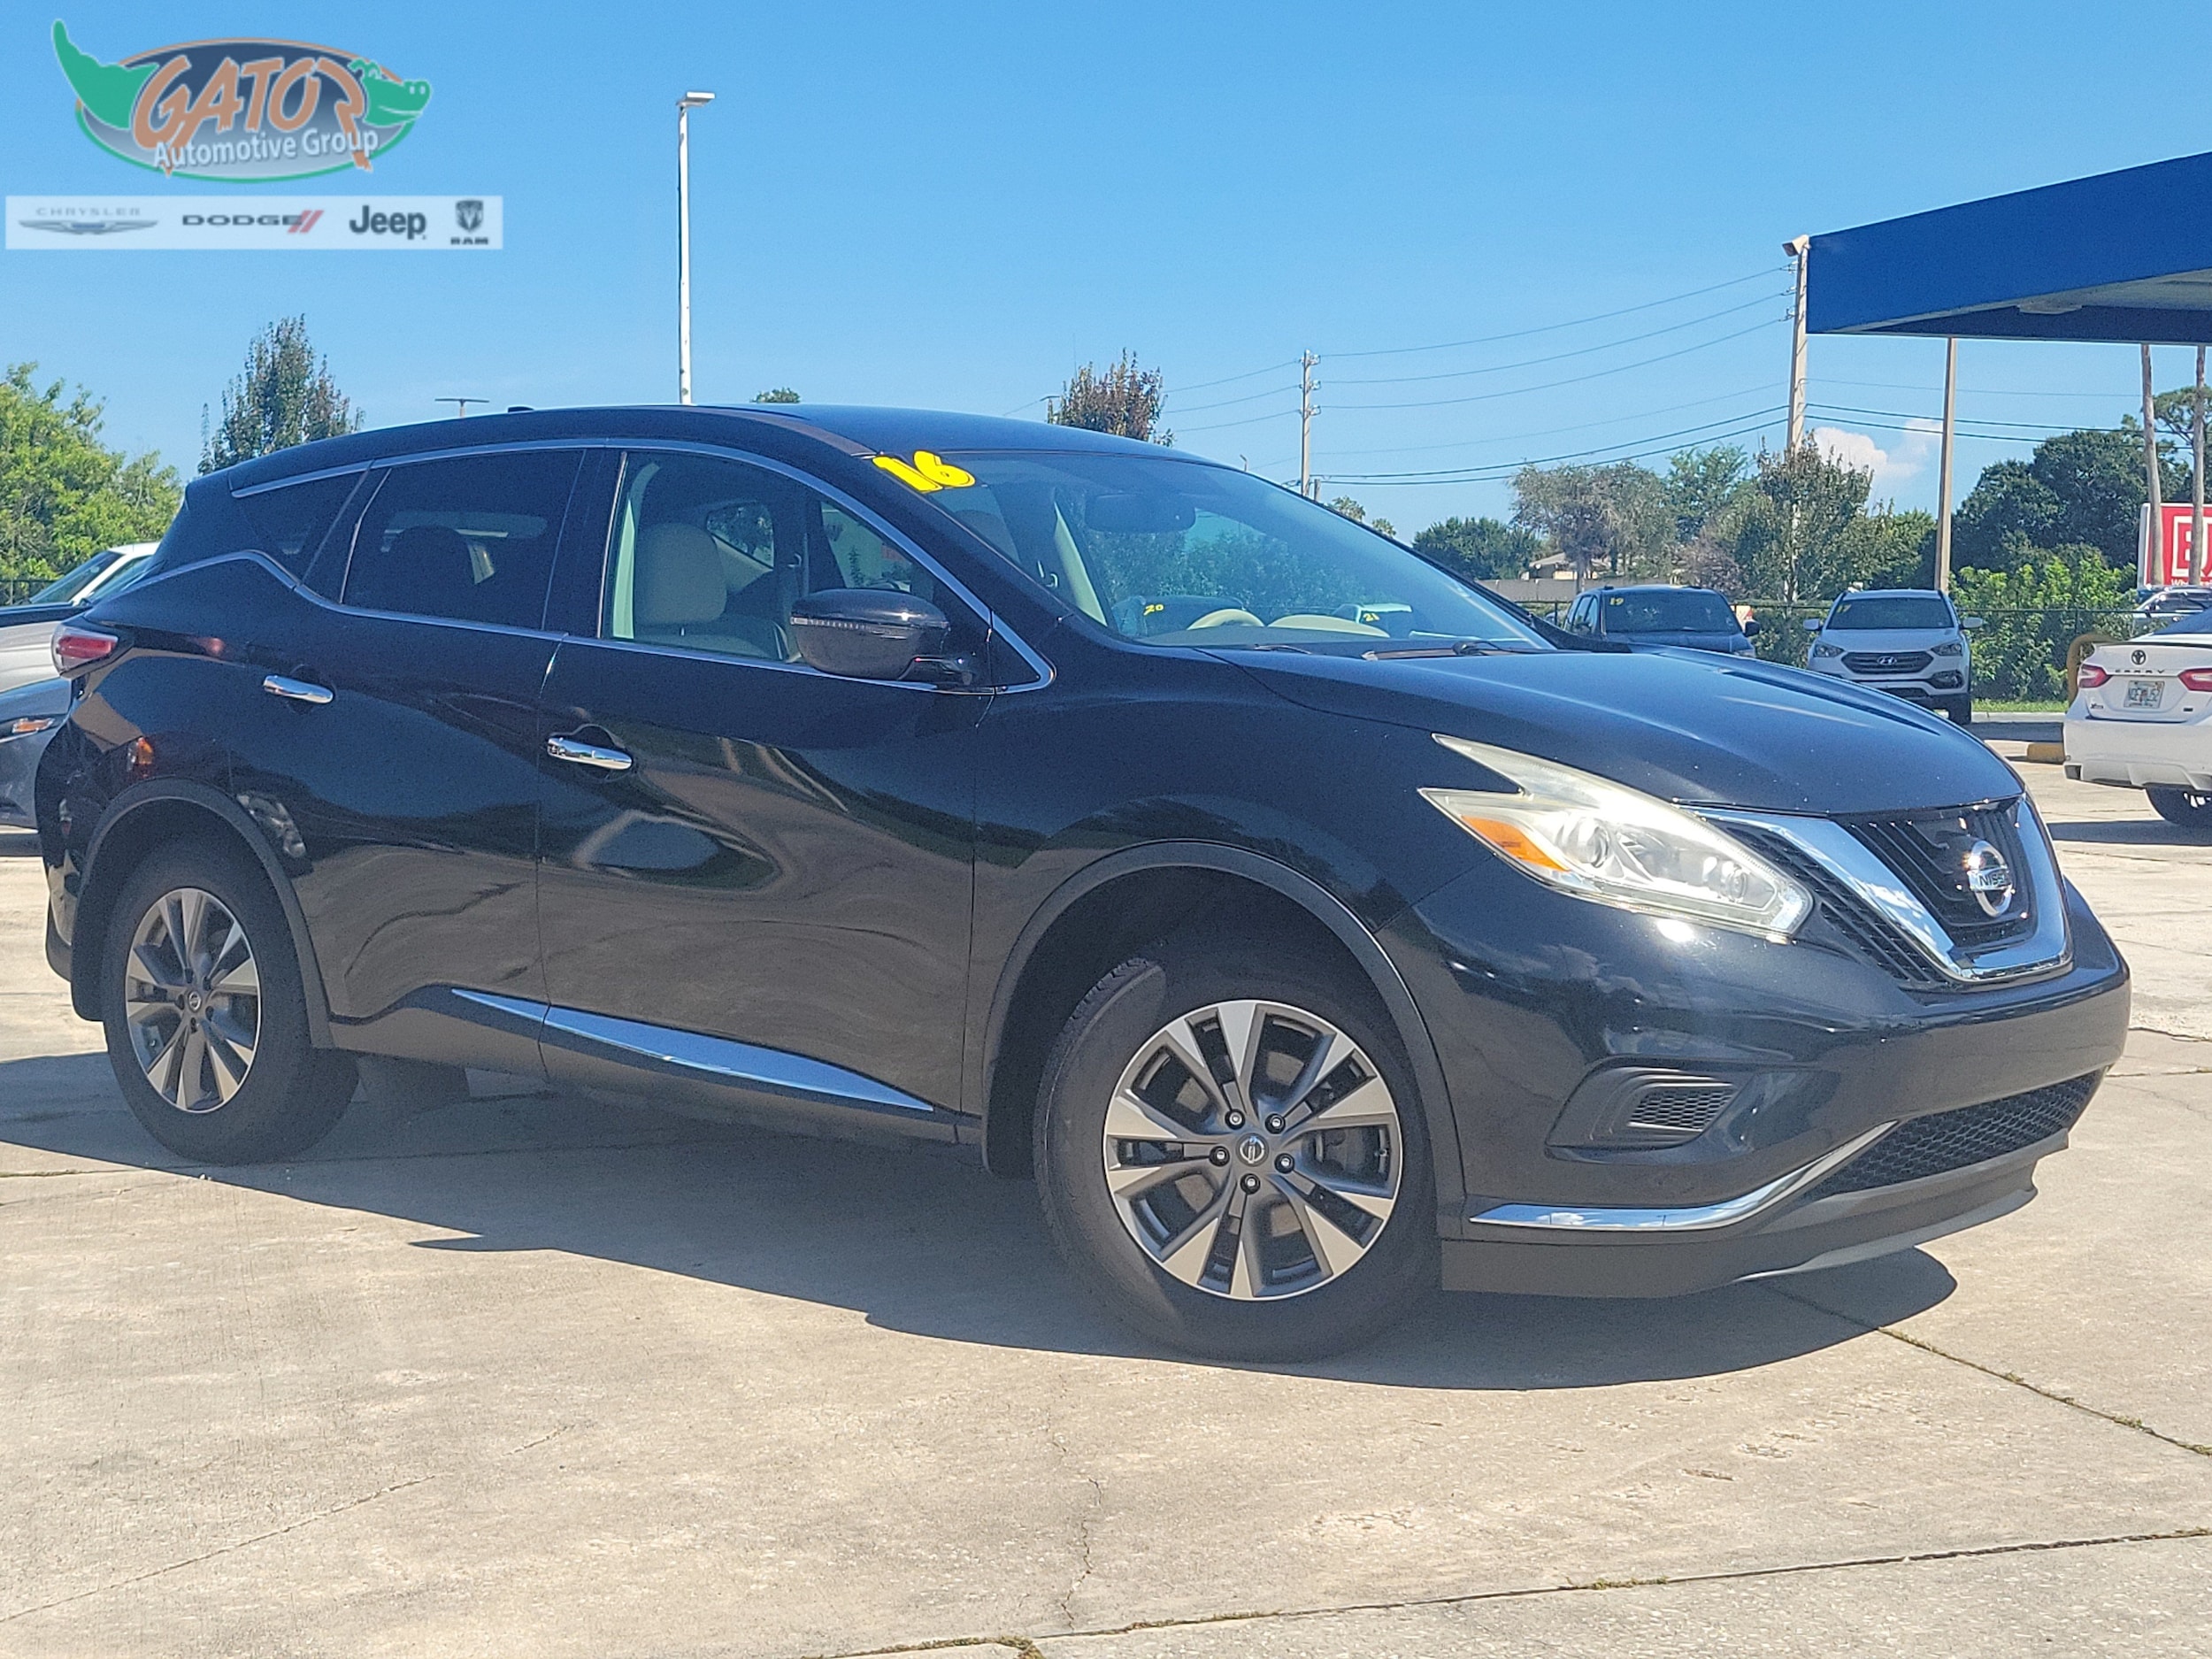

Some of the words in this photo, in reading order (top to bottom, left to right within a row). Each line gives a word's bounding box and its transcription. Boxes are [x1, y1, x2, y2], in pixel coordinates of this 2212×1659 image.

[872, 450, 976, 493] 16
[1609, 597, 1624, 606] 19
[1143, 603, 1164, 616] 20
[1363, 612, 1380, 622] 21
